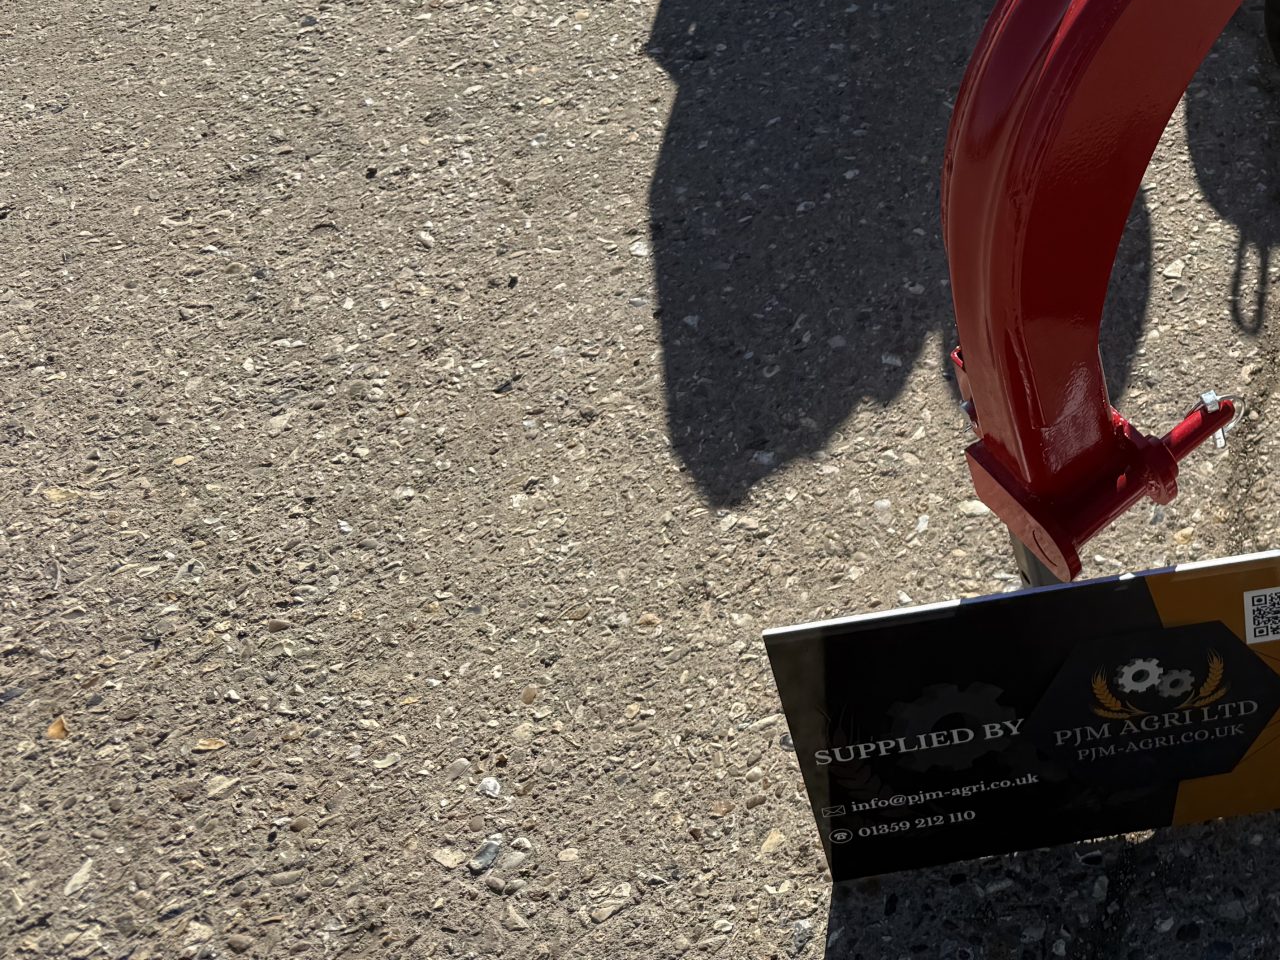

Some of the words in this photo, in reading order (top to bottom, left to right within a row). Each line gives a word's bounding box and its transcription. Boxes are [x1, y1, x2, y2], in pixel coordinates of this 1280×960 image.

[814, 727, 975, 766] SUPPLIED
[983, 718, 1025, 741] BY
[1053, 722, 1112, 747] PJM
[1119, 709, 1193, 737] AGRI
[1201, 699, 1259, 723] LTD
[1077, 723, 1246, 763] PJM-AGRI.CO.UK
[851, 772, 1039, 813] info@pjm-agri.co.uk
[858, 820, 911, 838] 01359
[915, 814, 945, 830] 212
[949, 809, 976, 824] 110
